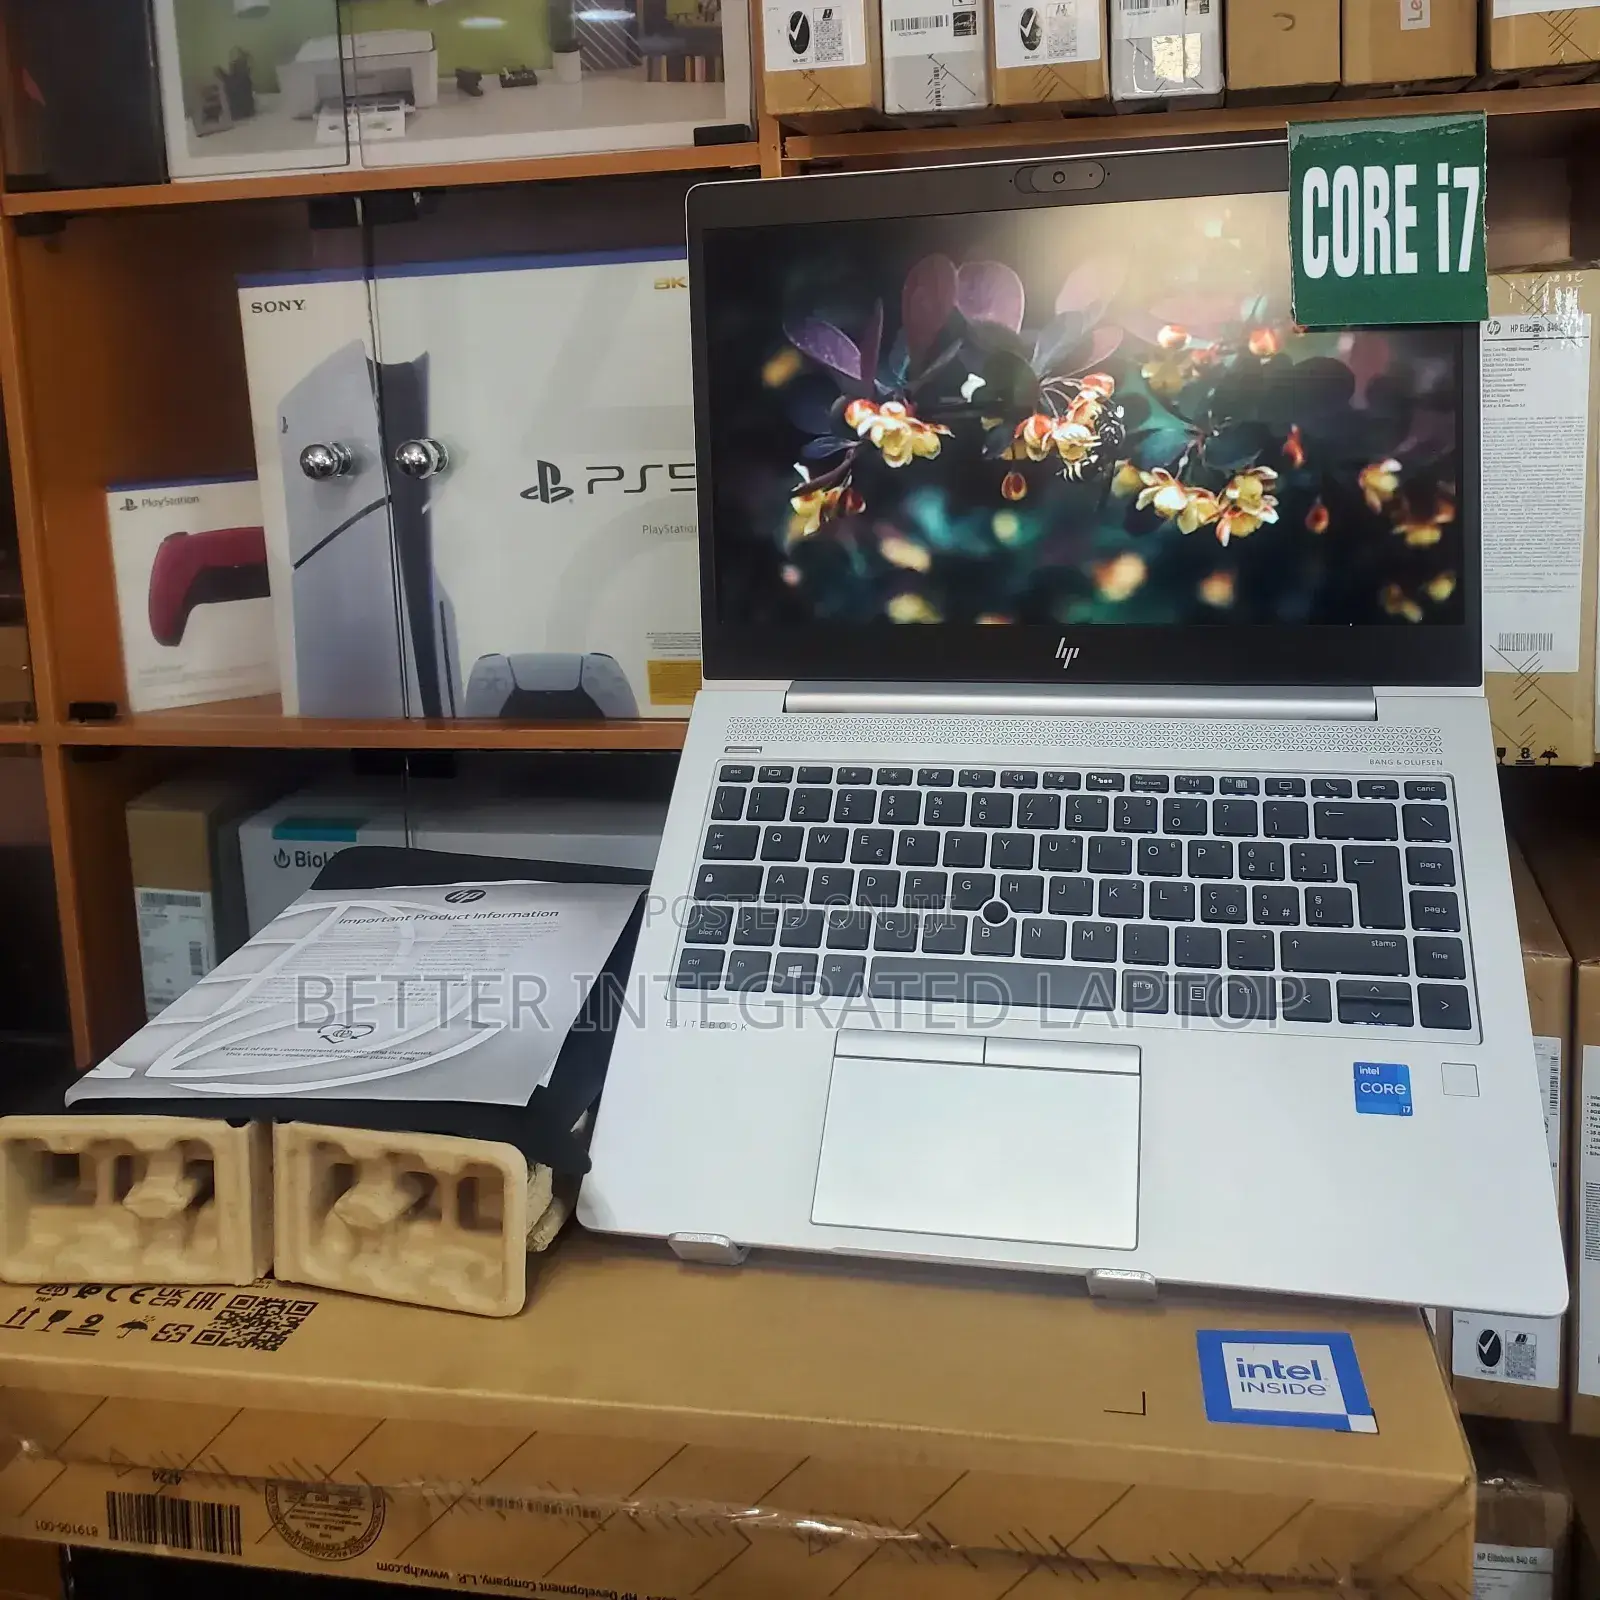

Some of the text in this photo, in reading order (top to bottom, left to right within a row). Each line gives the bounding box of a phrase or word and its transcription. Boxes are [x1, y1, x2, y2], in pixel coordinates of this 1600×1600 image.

[1302, 163, 1480, 279] CORE i7
[251, 299, 306, 314] SONY
[586, 463, 697, 494] PS5
[754, 805, 759, 813] 1
[798, 806, 805, 814] 2
[933, 810, 939, 818] 5
[772, 833, 781, 841] Q
[818, 834, 830, 843] W
[861, 836, 869, 844] E
[907, 837, 915, 846] R
[953, 839, 960, 847] T
[1002, 840, 1010, 849] Y
[1050, 842, 1057, 851] U
[1148, 846, 1158, 855] O
[1198, 848, 1205, 857] P
[776, 874, 784, 883] A
[822, 876, 828, 884] S
[867, 877, 875, 886] D
[914, 879, 921, 888] F
[962, 881, 971, 889] G
[1010, 883, 1018, 892] H
[1059, 885, 1065, 894] J
[1109, 888, 1117, 897] K
[1160, 890, 1167, 899] L
[339, 909, 560, 925] Important Product Information
[790, 917, 800, 927] Z
[837, 919, 847, 929] X
[885, 920, 895, 931] C
[933, 923, 943, 933] V
[982, 925, 993, 937] B
[1032, 928, 1041, 937] N
[1083, 930, 1093, 940] M
[665, 1018, 748, 1031] ELITEBOOK
[1359, 1065, 1380, 1076] intel
[1235, 1357, 1323, 1381] intel
